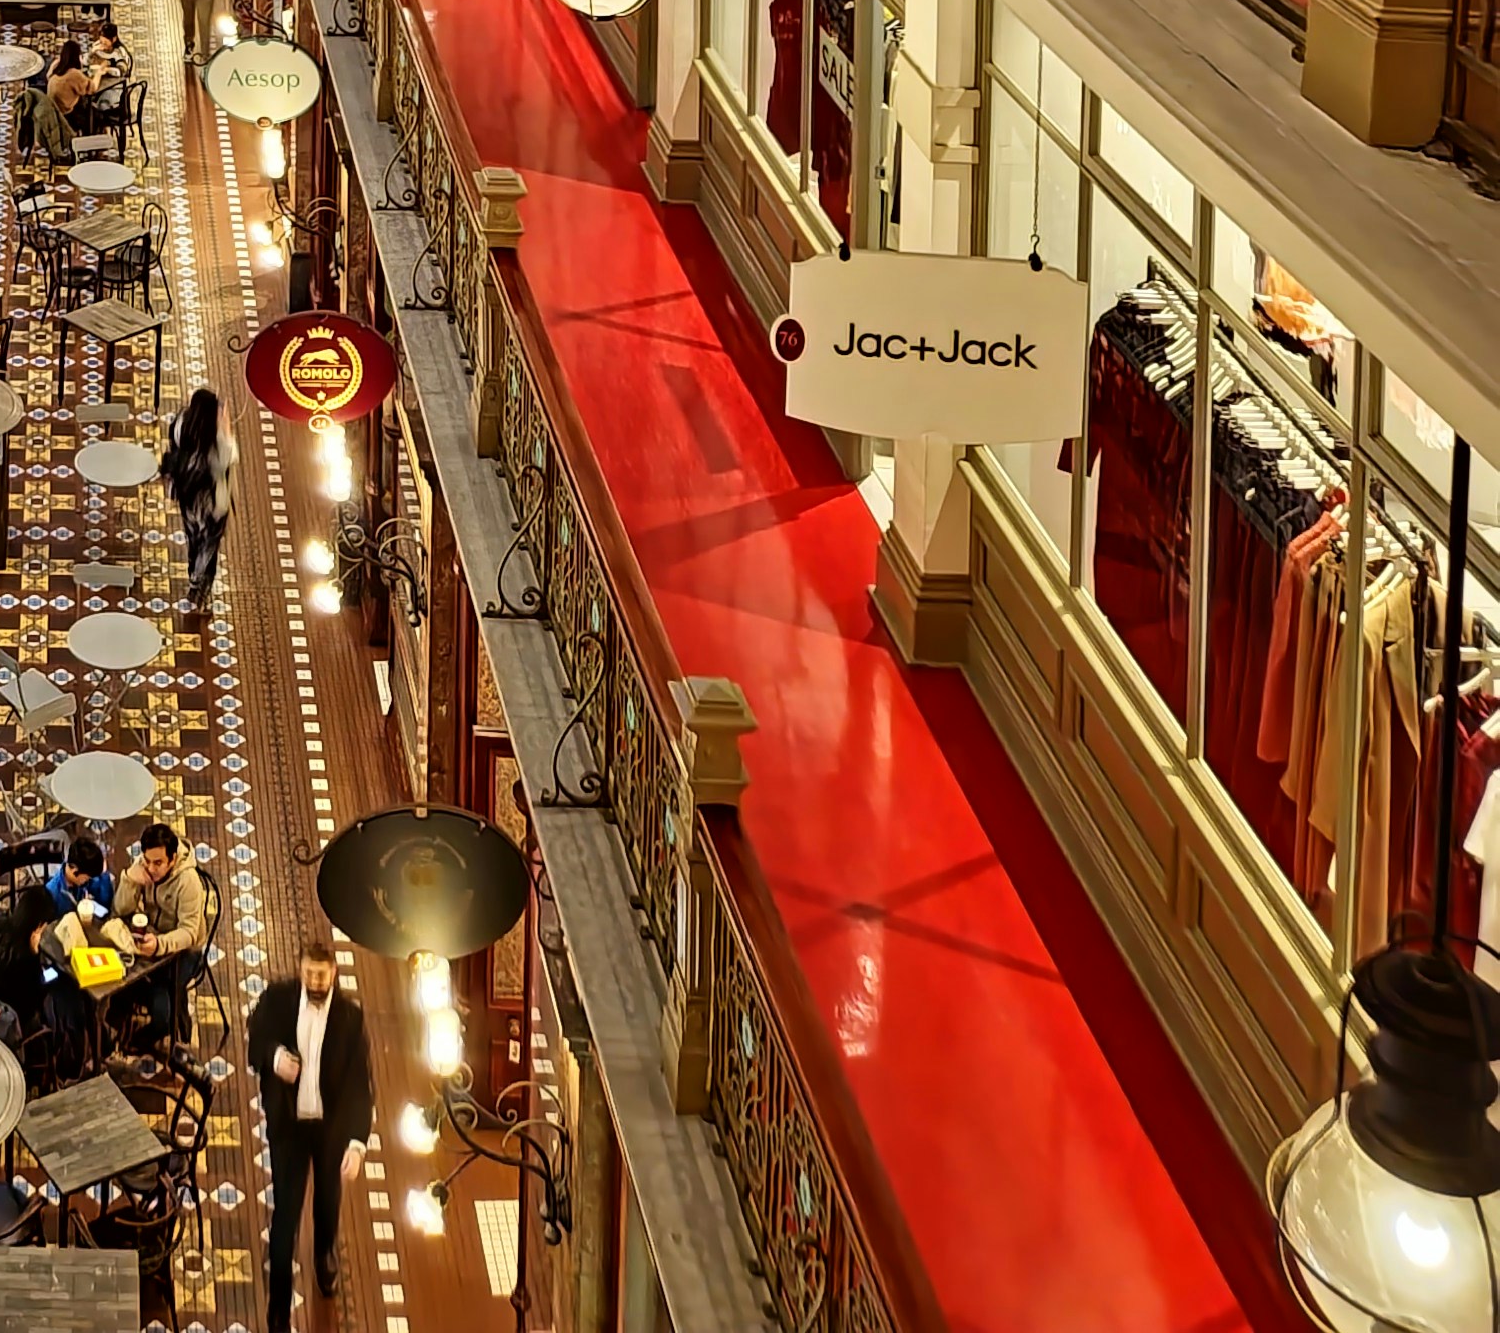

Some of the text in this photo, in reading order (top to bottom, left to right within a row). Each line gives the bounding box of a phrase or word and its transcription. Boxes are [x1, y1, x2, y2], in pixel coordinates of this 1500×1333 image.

[822, 44, 854, 111] SALE
[779, 331, 798, 346] 76
[833, 322, 1038, 370] Jac+Jack
[291, 368, 352, 380] ROMOLO
